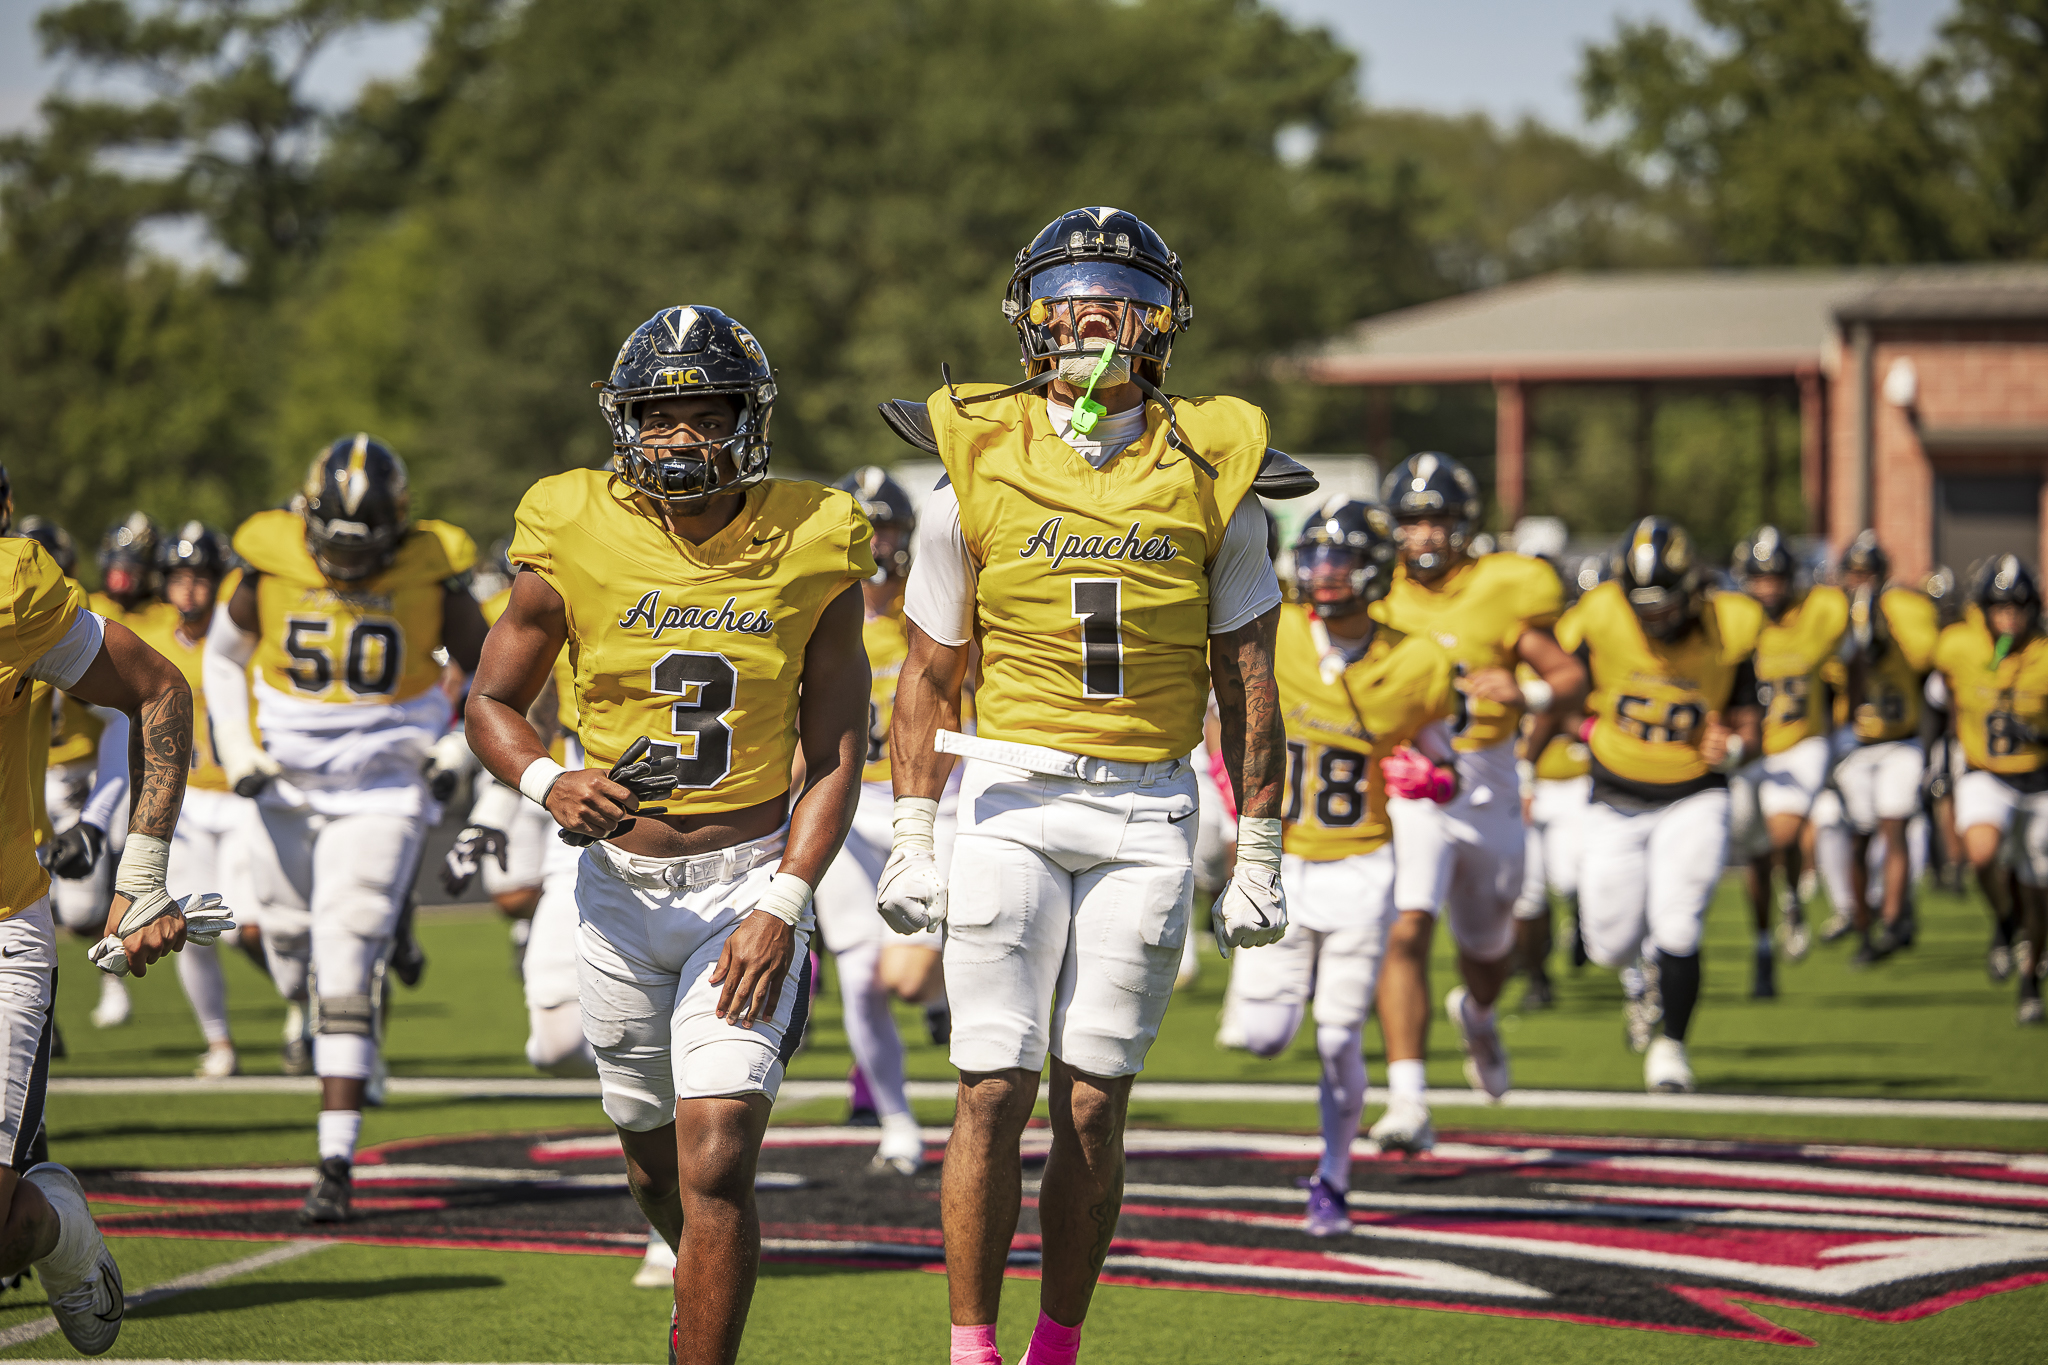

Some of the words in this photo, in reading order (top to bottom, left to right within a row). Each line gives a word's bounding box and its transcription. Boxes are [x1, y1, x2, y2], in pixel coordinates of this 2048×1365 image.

[662, 369, 699, 385] TJC
[1019, 516, 1178, 570] Apaches
[618, 589, 775, 640] Apaches
[1070, 578, 1124, 698] 1
[284, 613, 405, 698] 50
[161, 730, 188, 757] 30
[650, 649, 739, 789] 3
[1285, 738, 1368, 828] 18
